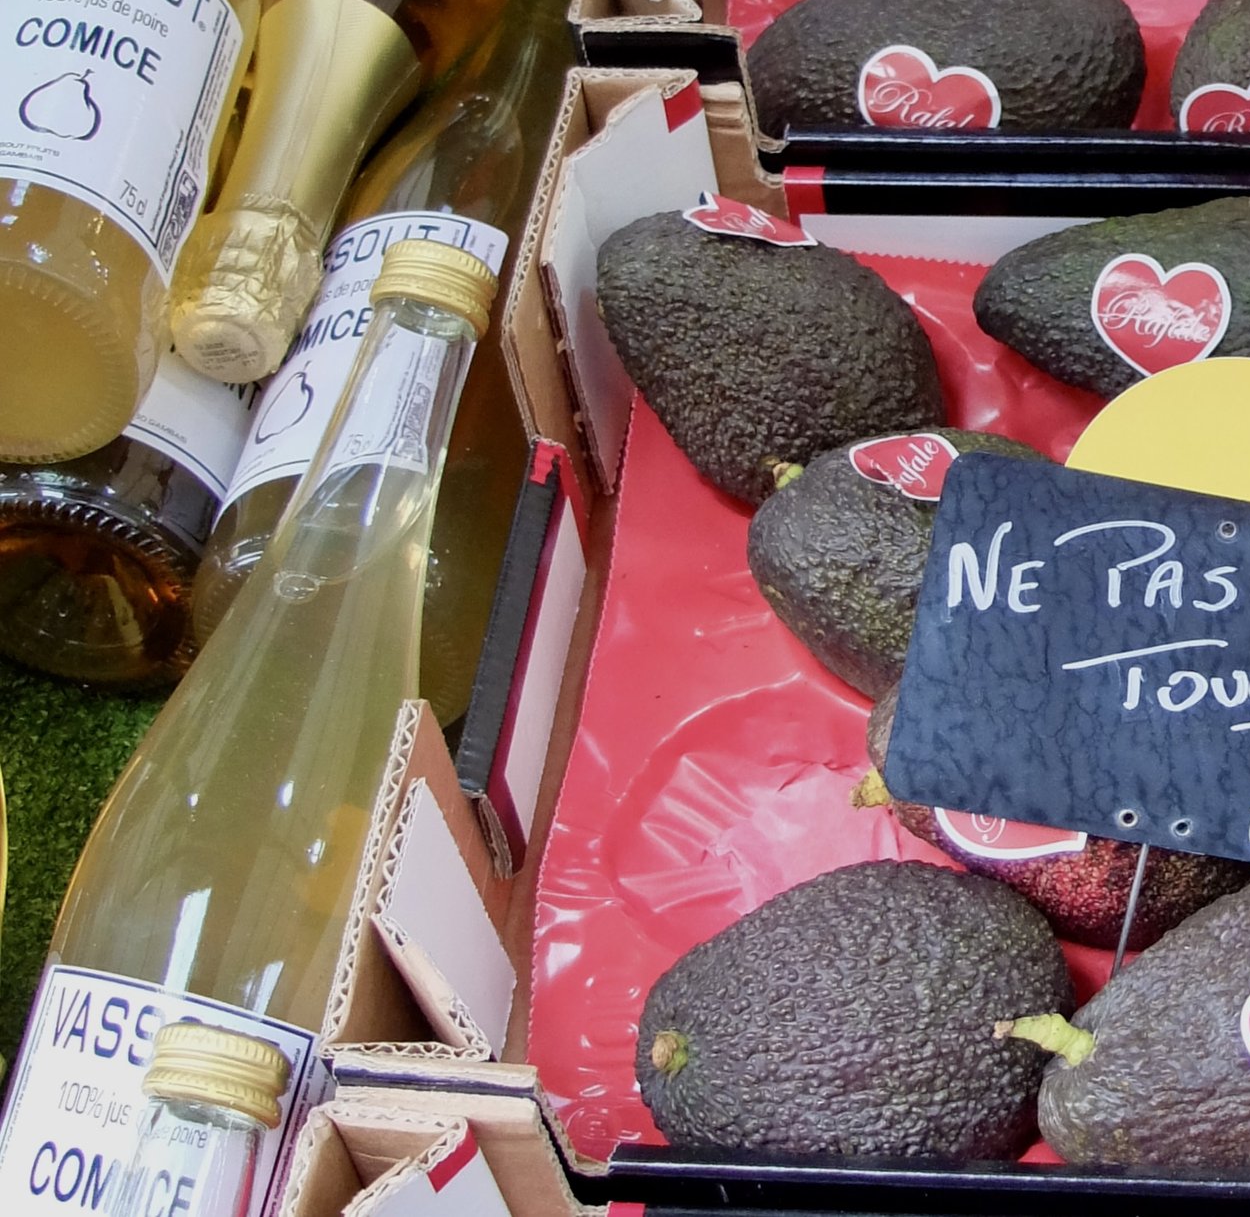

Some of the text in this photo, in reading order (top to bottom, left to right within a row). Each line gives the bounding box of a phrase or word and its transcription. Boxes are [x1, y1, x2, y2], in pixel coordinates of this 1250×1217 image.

[15, 16, 163, 86] COMICE
[132, 8, 169, 38] poire
[1100, 290, 1211, 349] Rafale
[947, 520, 1238, 613] NE PAS
[57, 1081, 104, 1119] 100%
[102, 1091, 132, 1128] jus
[168, 1125, 209, 1149] poire
